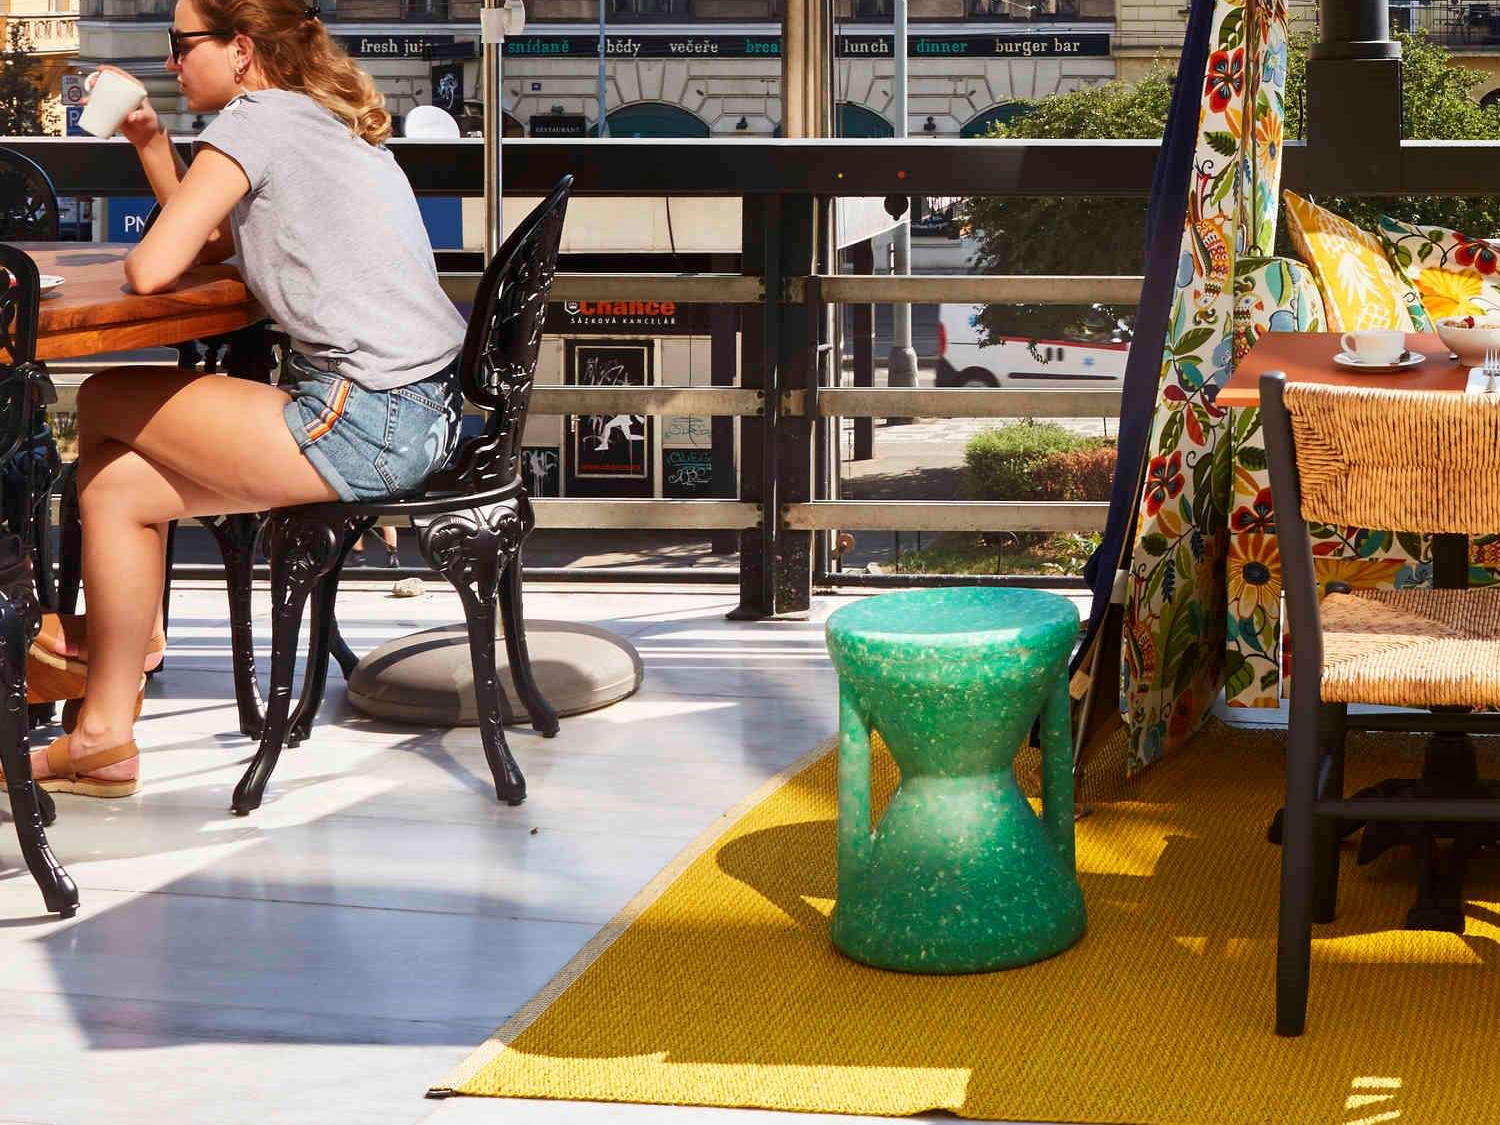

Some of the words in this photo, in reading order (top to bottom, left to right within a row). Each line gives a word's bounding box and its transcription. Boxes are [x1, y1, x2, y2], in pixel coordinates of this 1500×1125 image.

[360, 38, 398, 53] fresh
[403, 39, 437, 57] jui
[508, 39, 569, 54] snídaně
[669, 40, 719, 53] večeře
[745, 38, 782, 53] brea
[844, 38, 889, 53] lunch
[916, 38, 967, 53] dinner
[995, 39, 1048, 56] burger
[1054, 38, 1080, 52] bar
[580, 299, 676, 315] Chance
